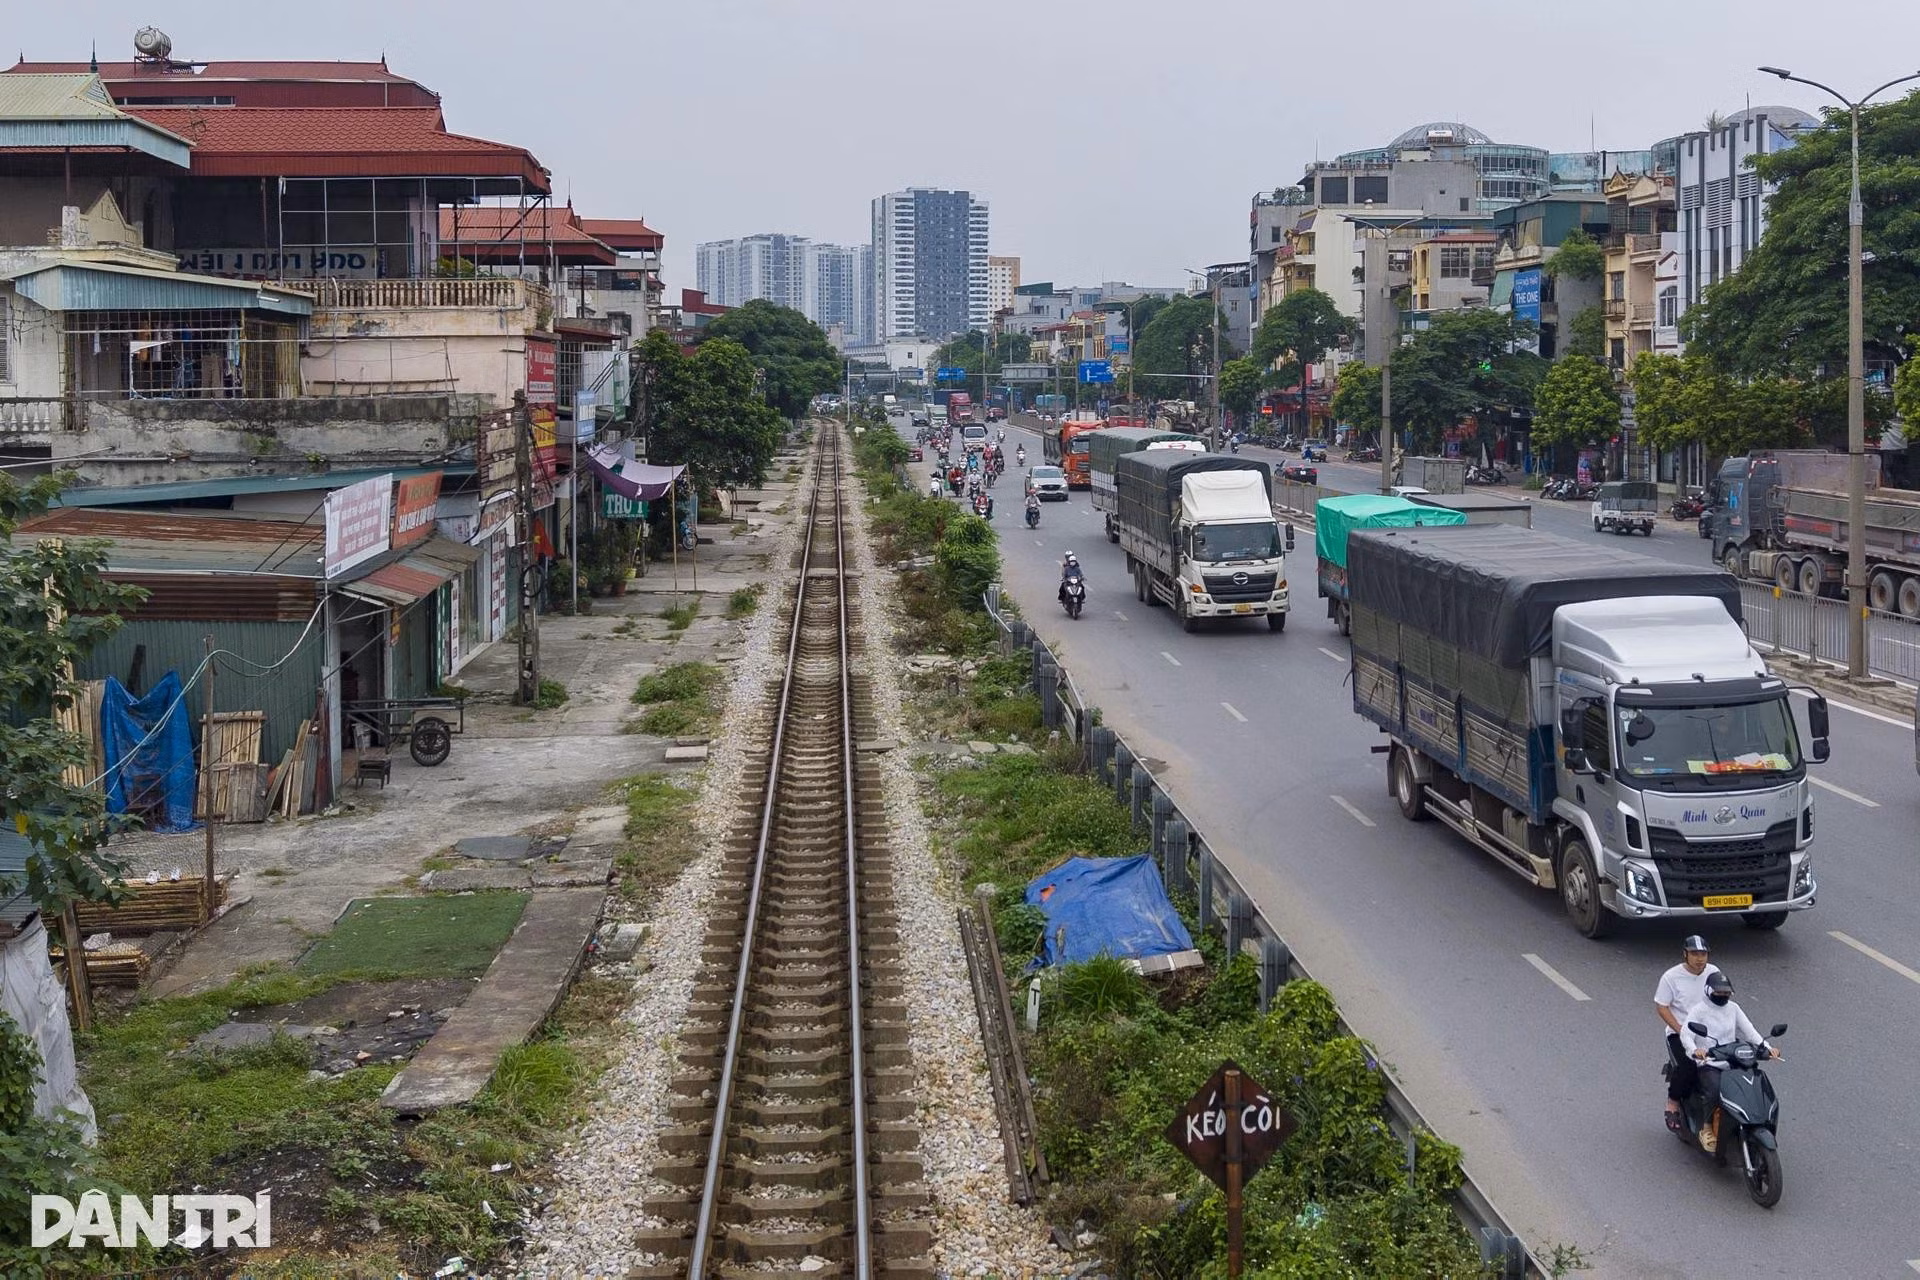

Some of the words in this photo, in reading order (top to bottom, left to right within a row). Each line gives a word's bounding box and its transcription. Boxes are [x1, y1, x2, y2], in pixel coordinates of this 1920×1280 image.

[1515, 292, 1526, 304] THE
[1527, 290, 1538, 303] ONE
[1240, 1094, 1281, 1134] CÒI
